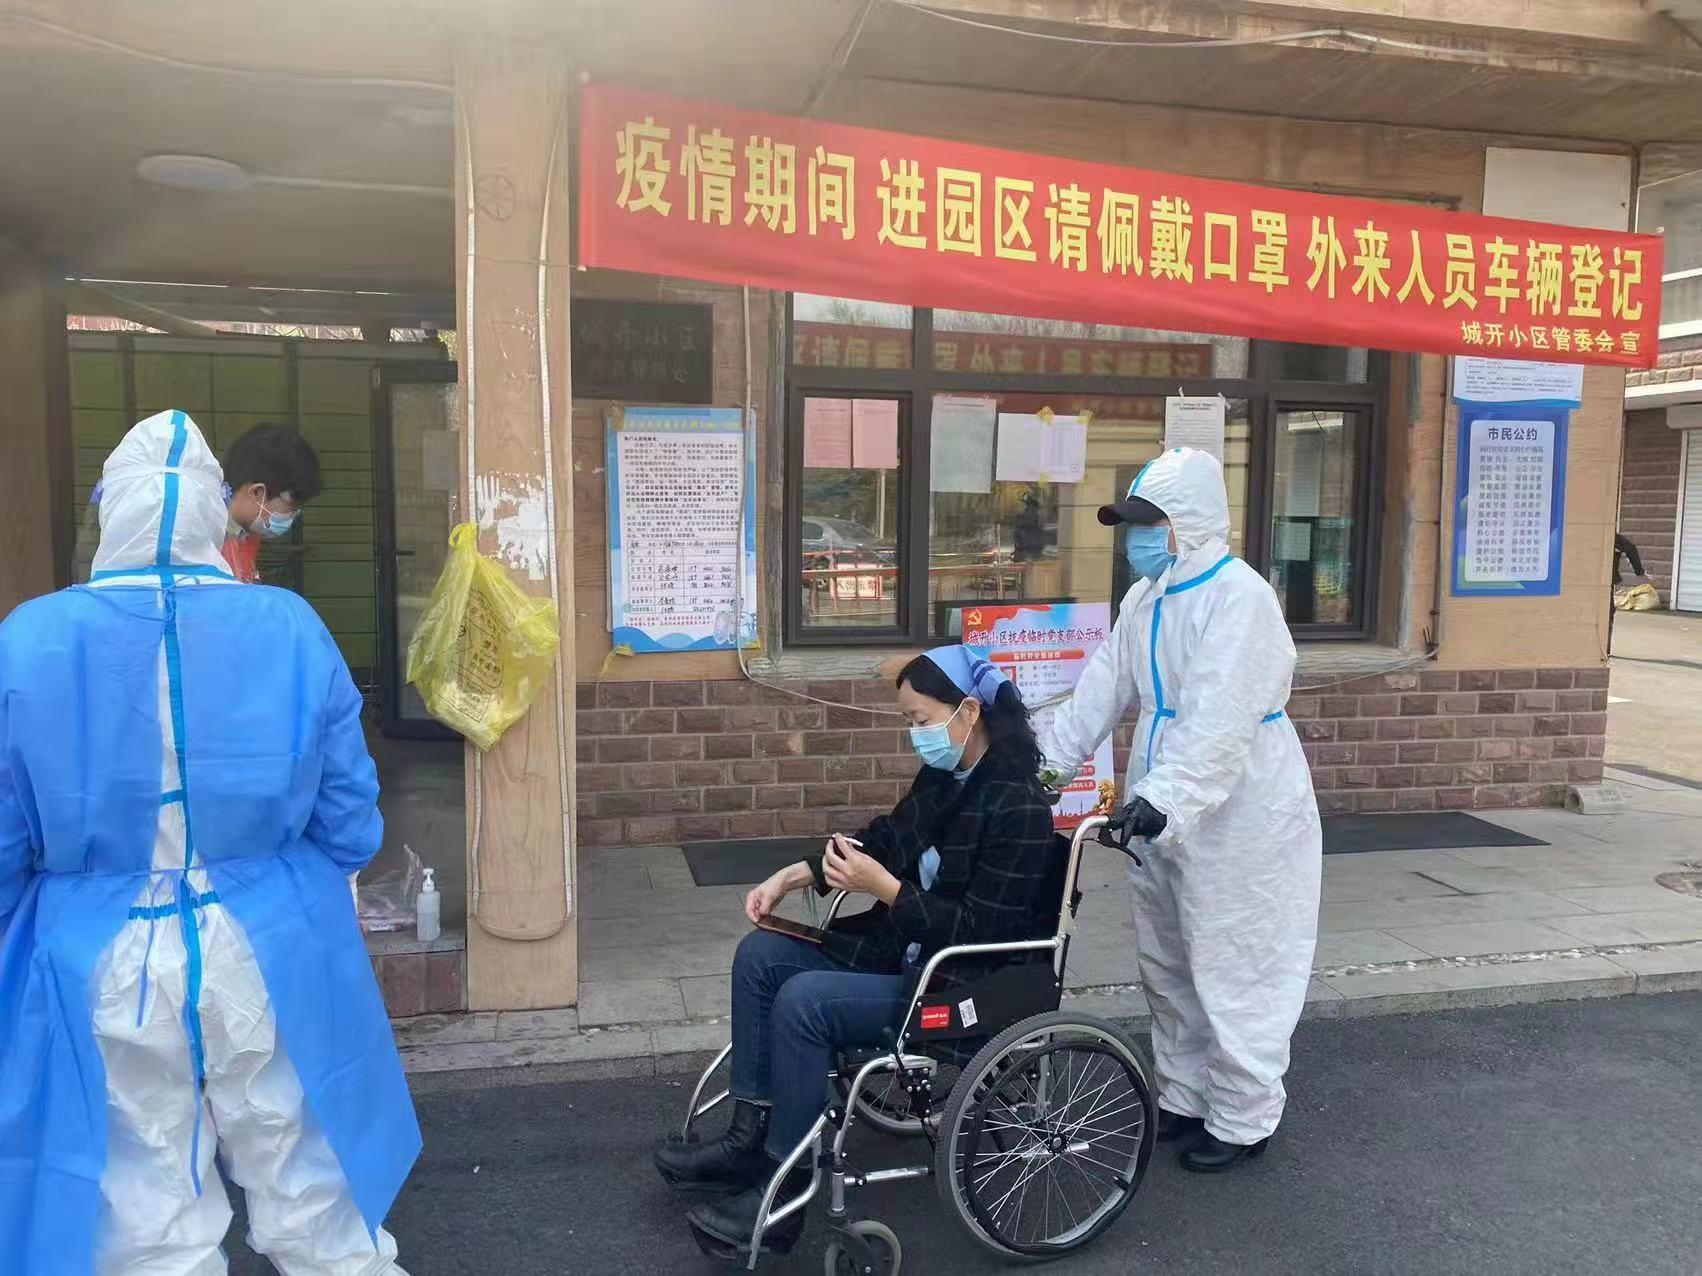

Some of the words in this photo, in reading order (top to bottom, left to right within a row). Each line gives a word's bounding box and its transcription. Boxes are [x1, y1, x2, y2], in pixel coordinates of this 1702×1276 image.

[615, 116, 856, 240] 疫情期间
[875, 157, 1290, 293] 进园区请佩戴口罩
[1306, 214, 1643, 322] 外来人员车辆登记
[1460, 321, 1615, 353] 城开小区管委会
[1620, 331, 1640, 355] 宣
[1487, 427, 1538, 441] 市民公约
[967, 627, 1104, 647] 城开小区抗疫临时党支部公示板
